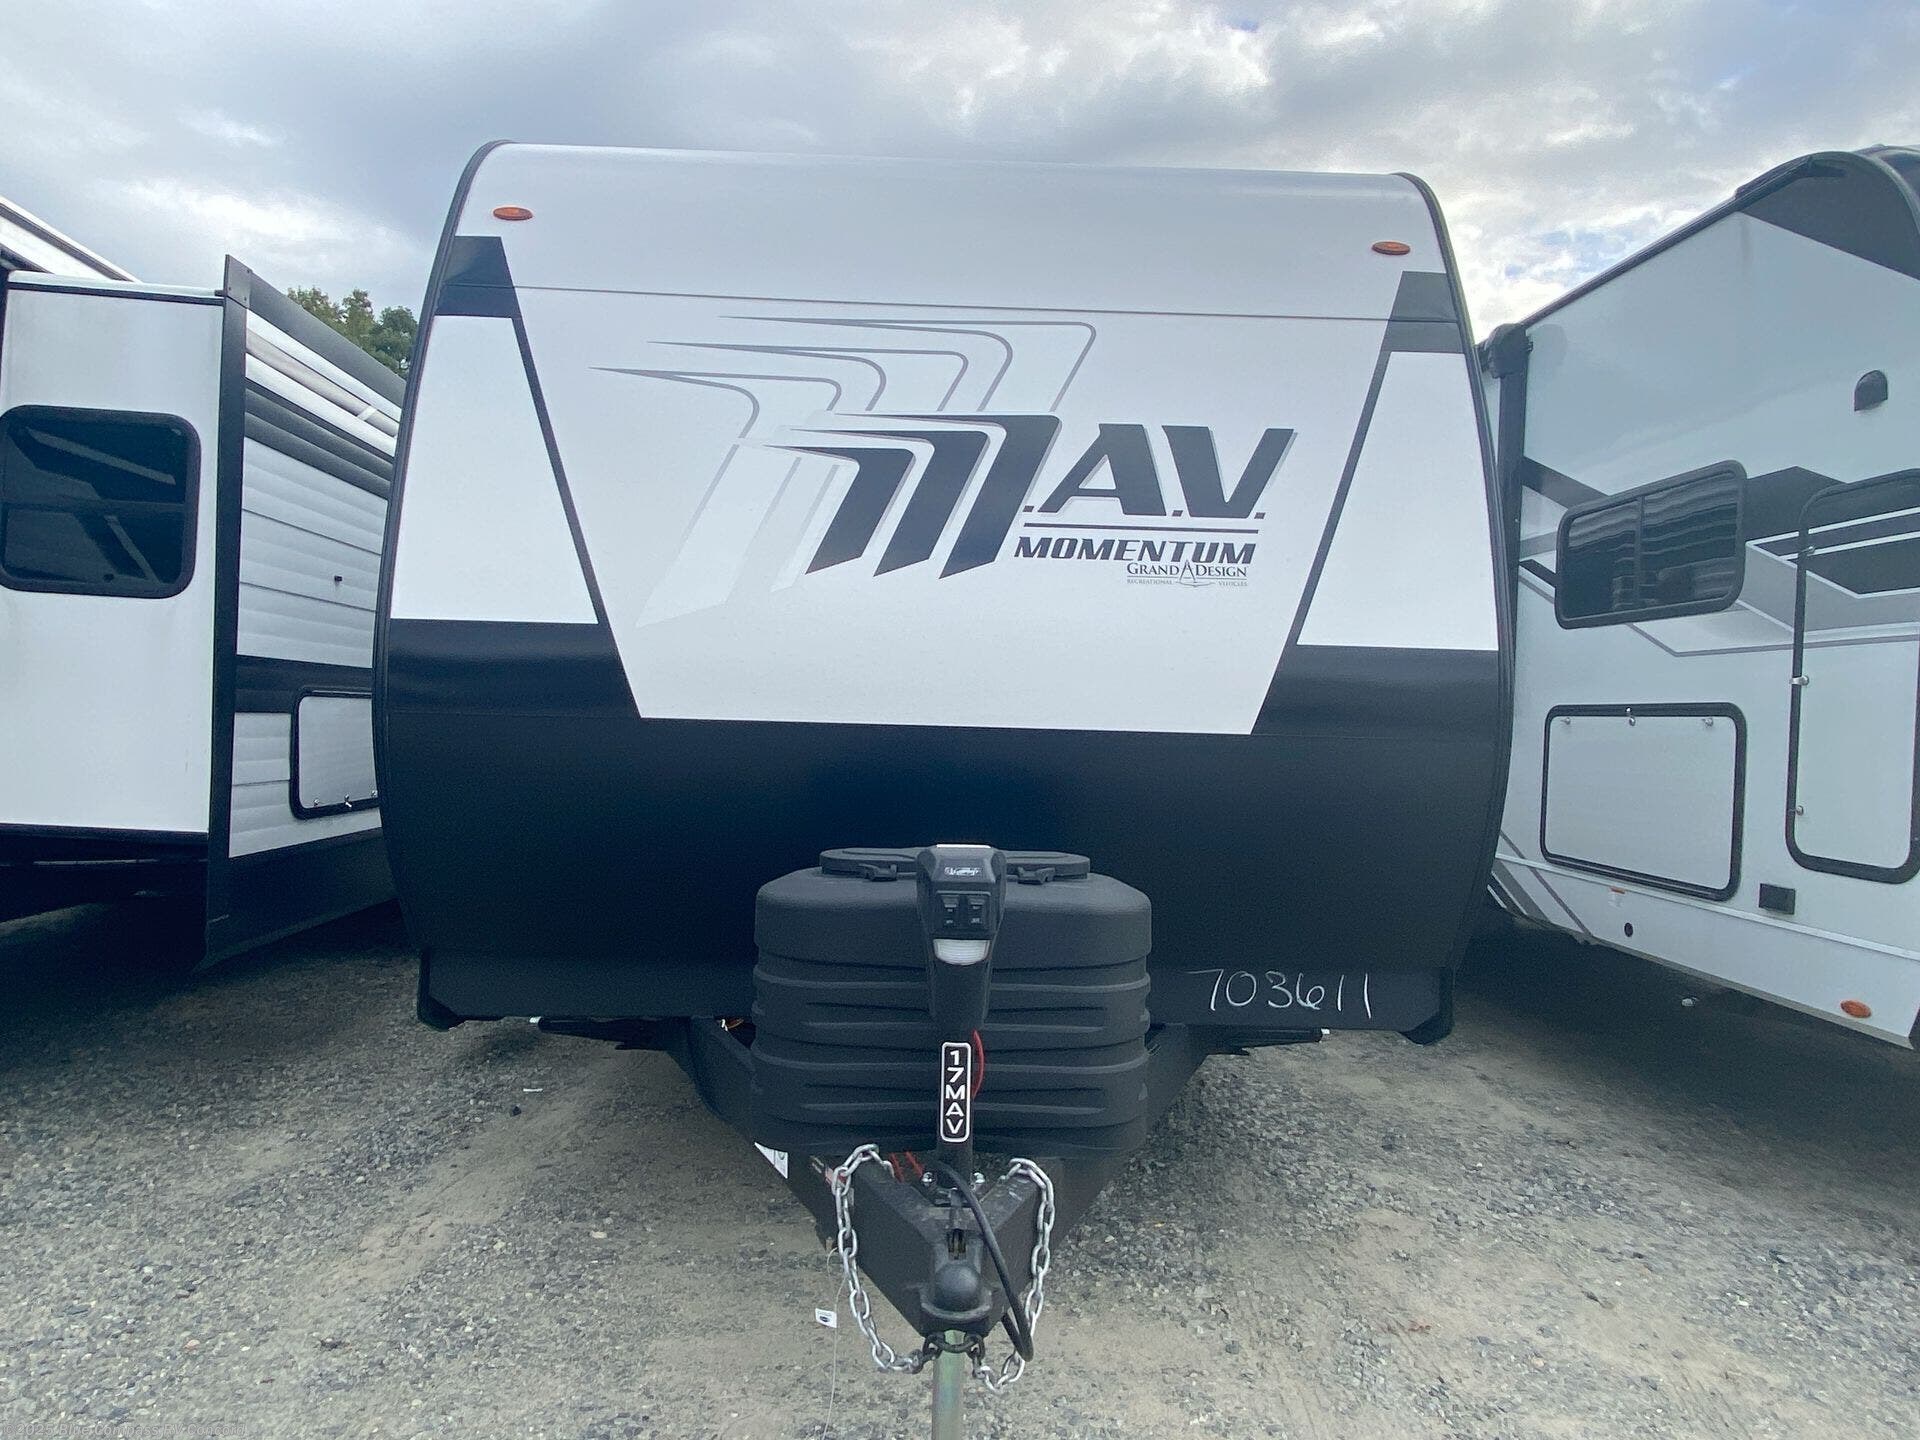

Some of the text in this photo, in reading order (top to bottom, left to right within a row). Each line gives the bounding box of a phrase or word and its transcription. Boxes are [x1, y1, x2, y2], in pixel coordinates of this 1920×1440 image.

[1013, 536, 1257, 565] MOMENTUM
[1126, 562, 1248, 577] GRAND DESIGN
[1186, 968, 1372, 1020] 703611
[944, 1050, 966, 1134] 17MAV
